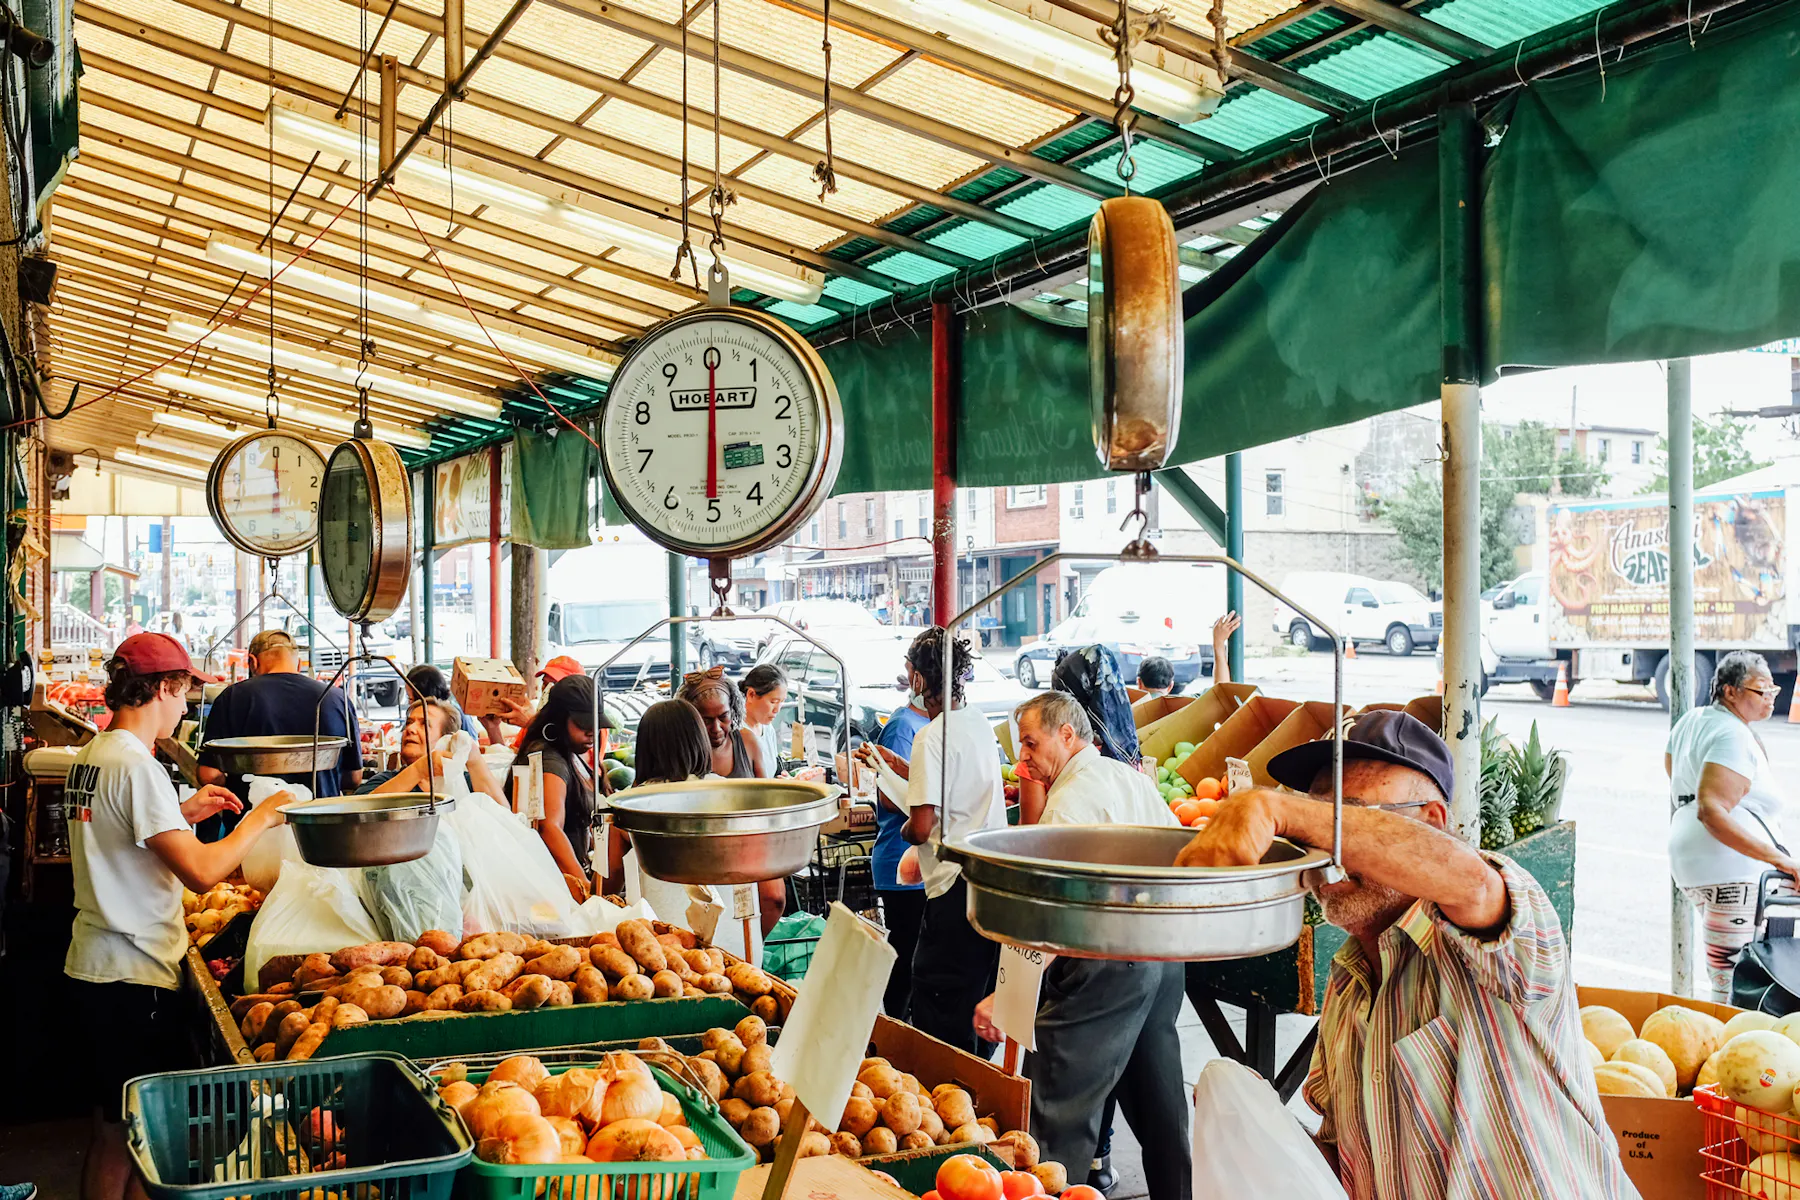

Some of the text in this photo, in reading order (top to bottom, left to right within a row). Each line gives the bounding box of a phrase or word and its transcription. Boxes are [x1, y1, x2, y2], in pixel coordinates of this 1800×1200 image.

[703, 346, 721, 371] 0
[662, 363, 678, 387] 9
[749, 358, 758, 383] 1
[679, 391, 749, 405] HOBART
[774, 395, 792, 420] 2
[635, 401, 651, 425] 8
[272, 446, 280, 458] 0
[297, 455, 301, 467] 1
[637, 449, 654, 474] 7
[776, 444, 792, 468] 3
[310, 476, 318, 488] 2
[664, 486, 680, 510] 6
[746, 482, 764, 506] 4
[310, 501, 318, 513] 3
[706, 499, 721, 522] 5
[1591, 603, 1609, 614] FISH
[1611, 603, 1645, 614] MARKET
[1715, 601, 1735, 613] BAR
[1622, 1130, 1660, 1140] Produce
[1636, 1141, 1646, 1149] of
[1629, 1150, 1654, 1160] U.S.A
